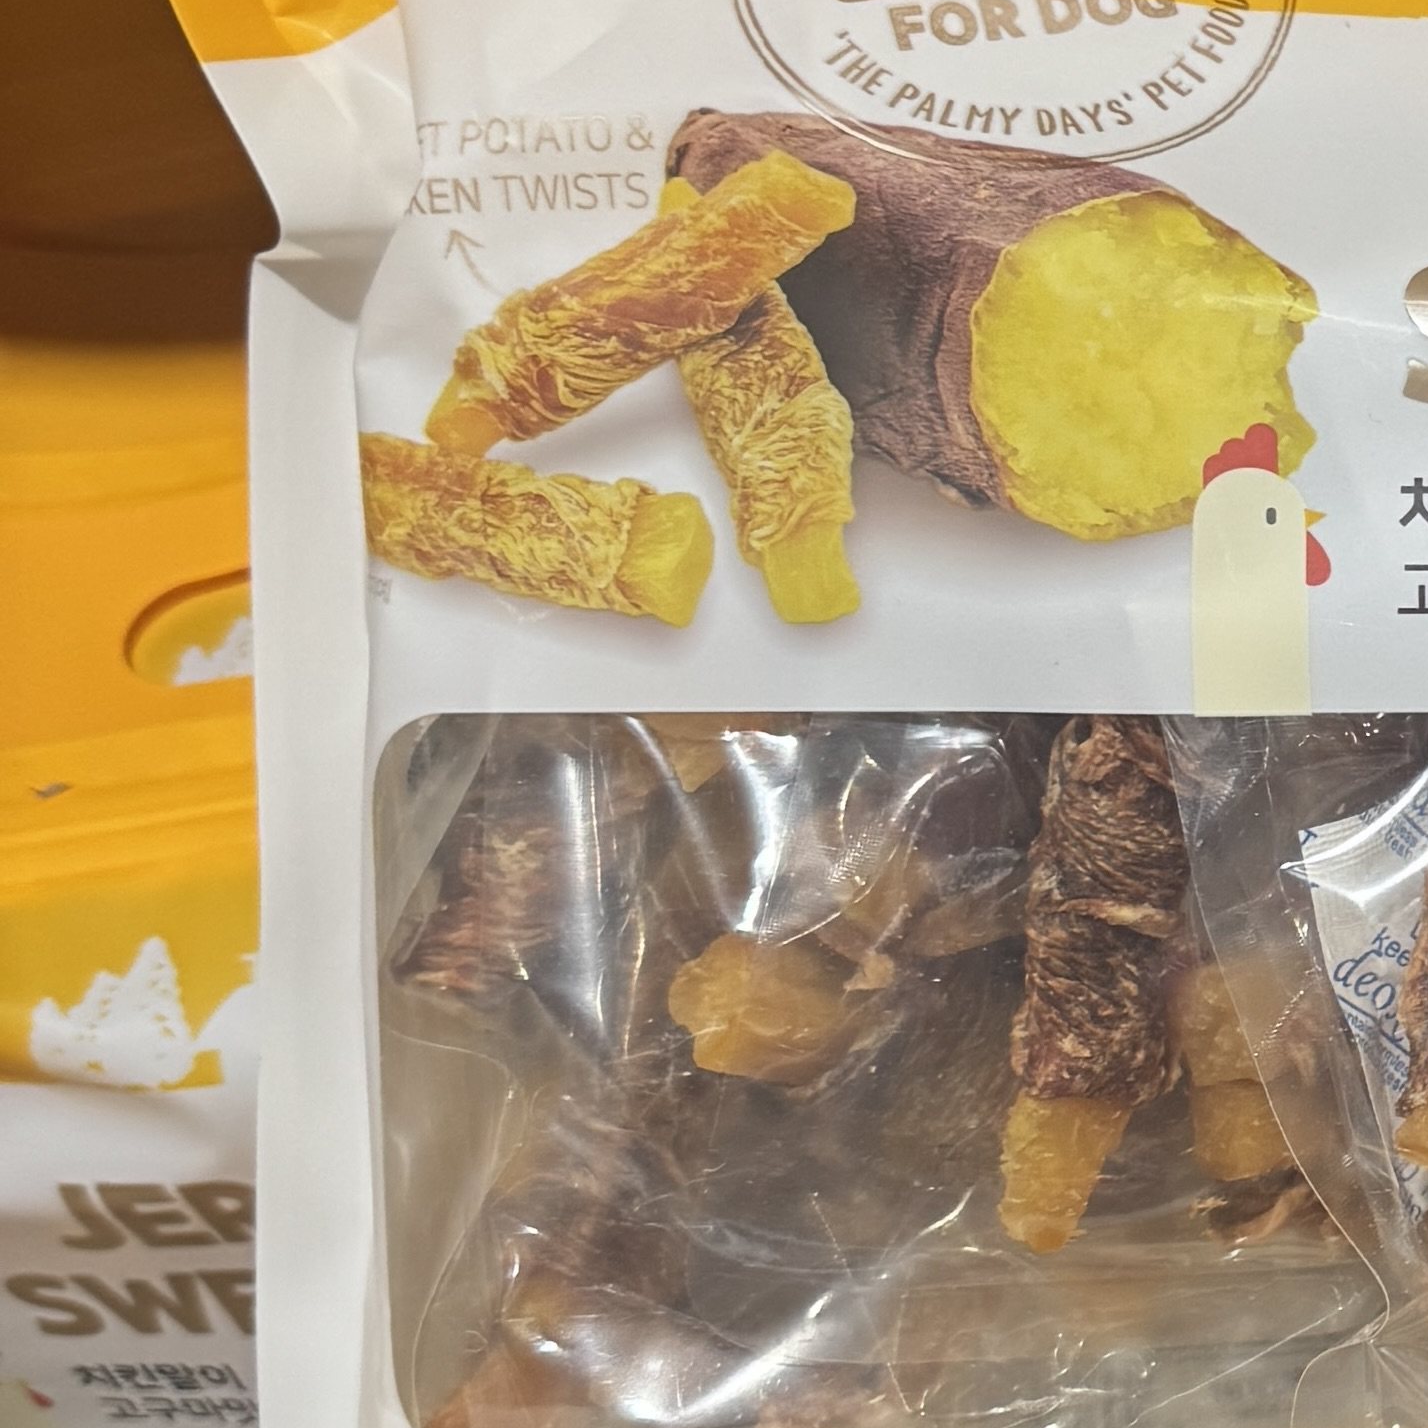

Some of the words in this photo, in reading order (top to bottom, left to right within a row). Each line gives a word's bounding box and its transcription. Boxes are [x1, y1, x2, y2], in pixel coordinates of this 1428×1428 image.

[887, 1, 1026, 52] FOR
[887, 81, 1024, 137] PALMY
[1144, 52, 1209, 113] PET
[457, 115, 613, 156] POTATO
[625, 116, 655, 153] &
[491, 171, 651, 213] TWISTS
[57, 1179, 256, 1251] JER
